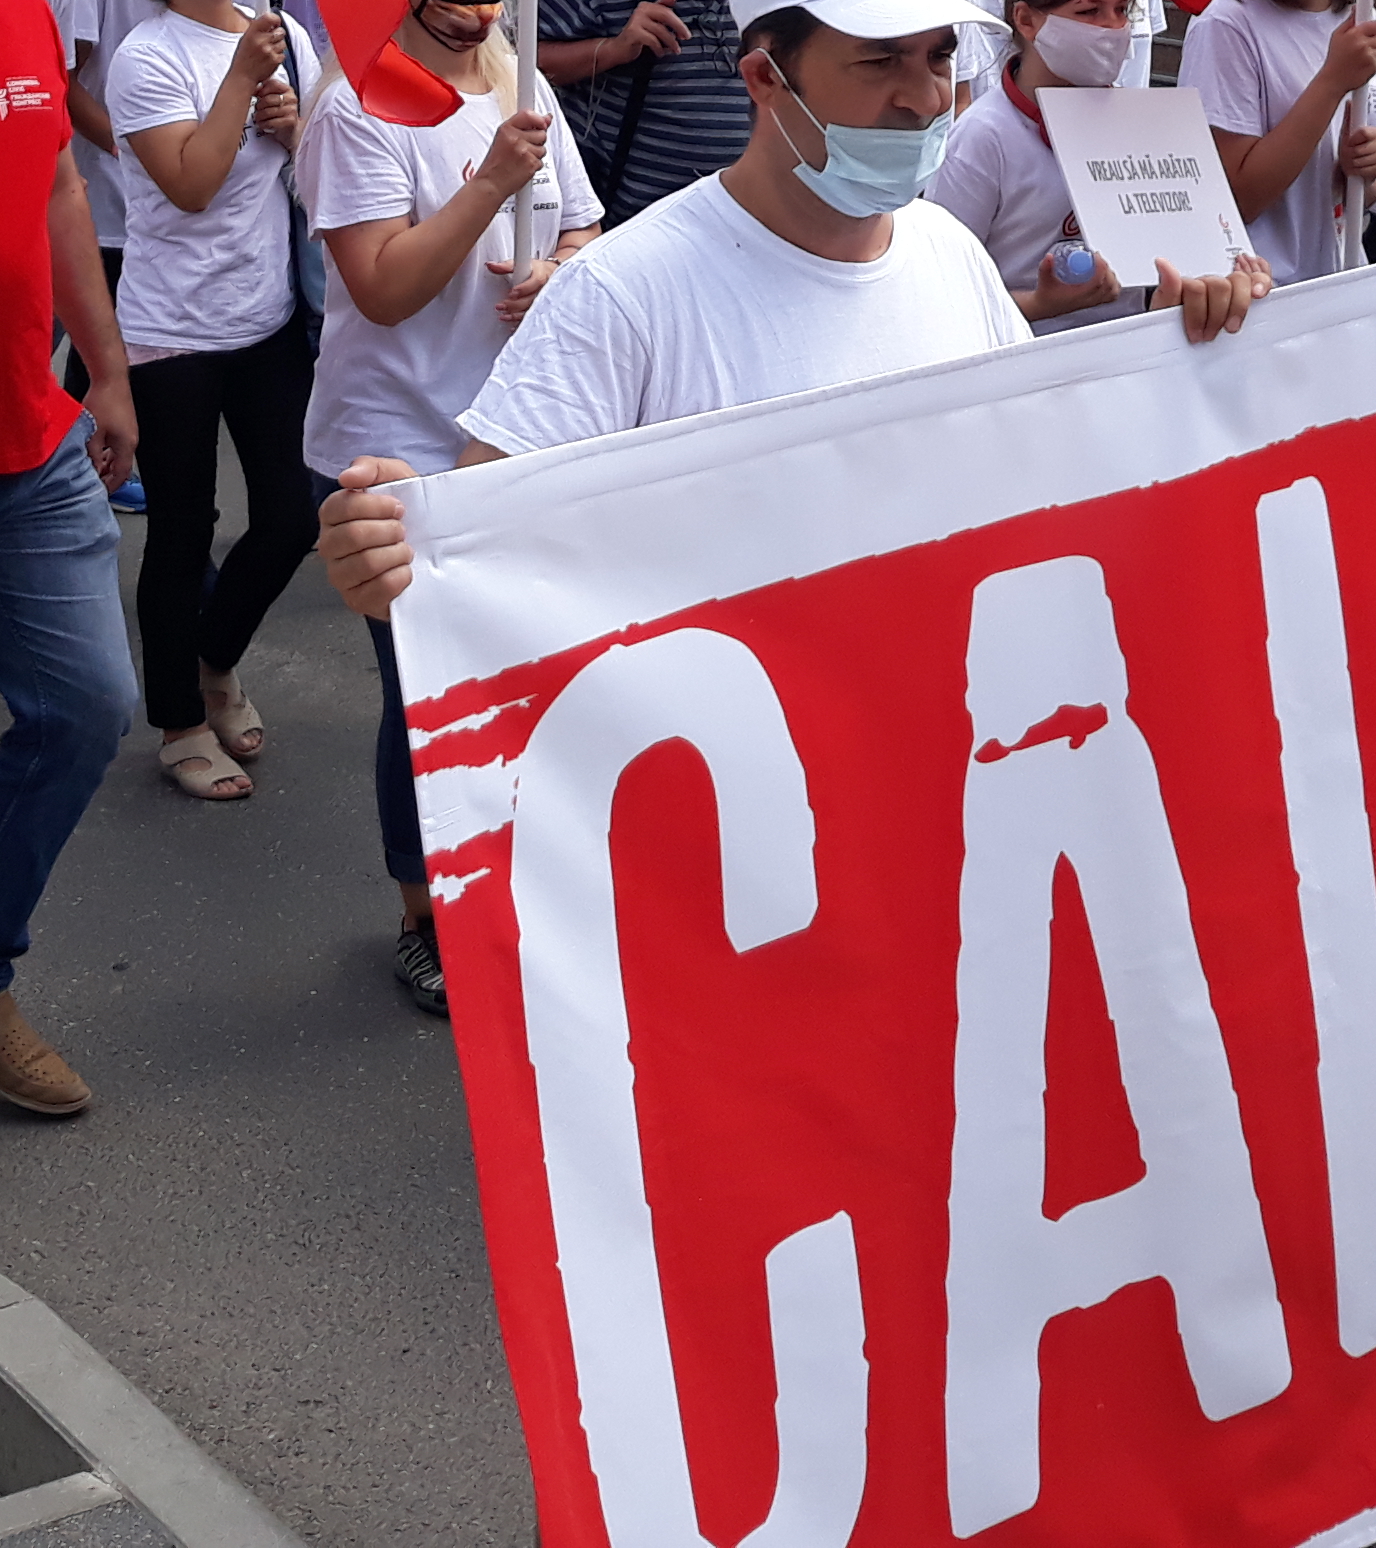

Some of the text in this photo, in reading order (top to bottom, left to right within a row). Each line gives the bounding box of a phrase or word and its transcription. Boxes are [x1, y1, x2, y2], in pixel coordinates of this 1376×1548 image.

[1087, 153, 1202, 185] VREAU SĂ MĂ ARĂTAȚI
[1118, 190, 1193, 215] LA TELEVIZOR!
